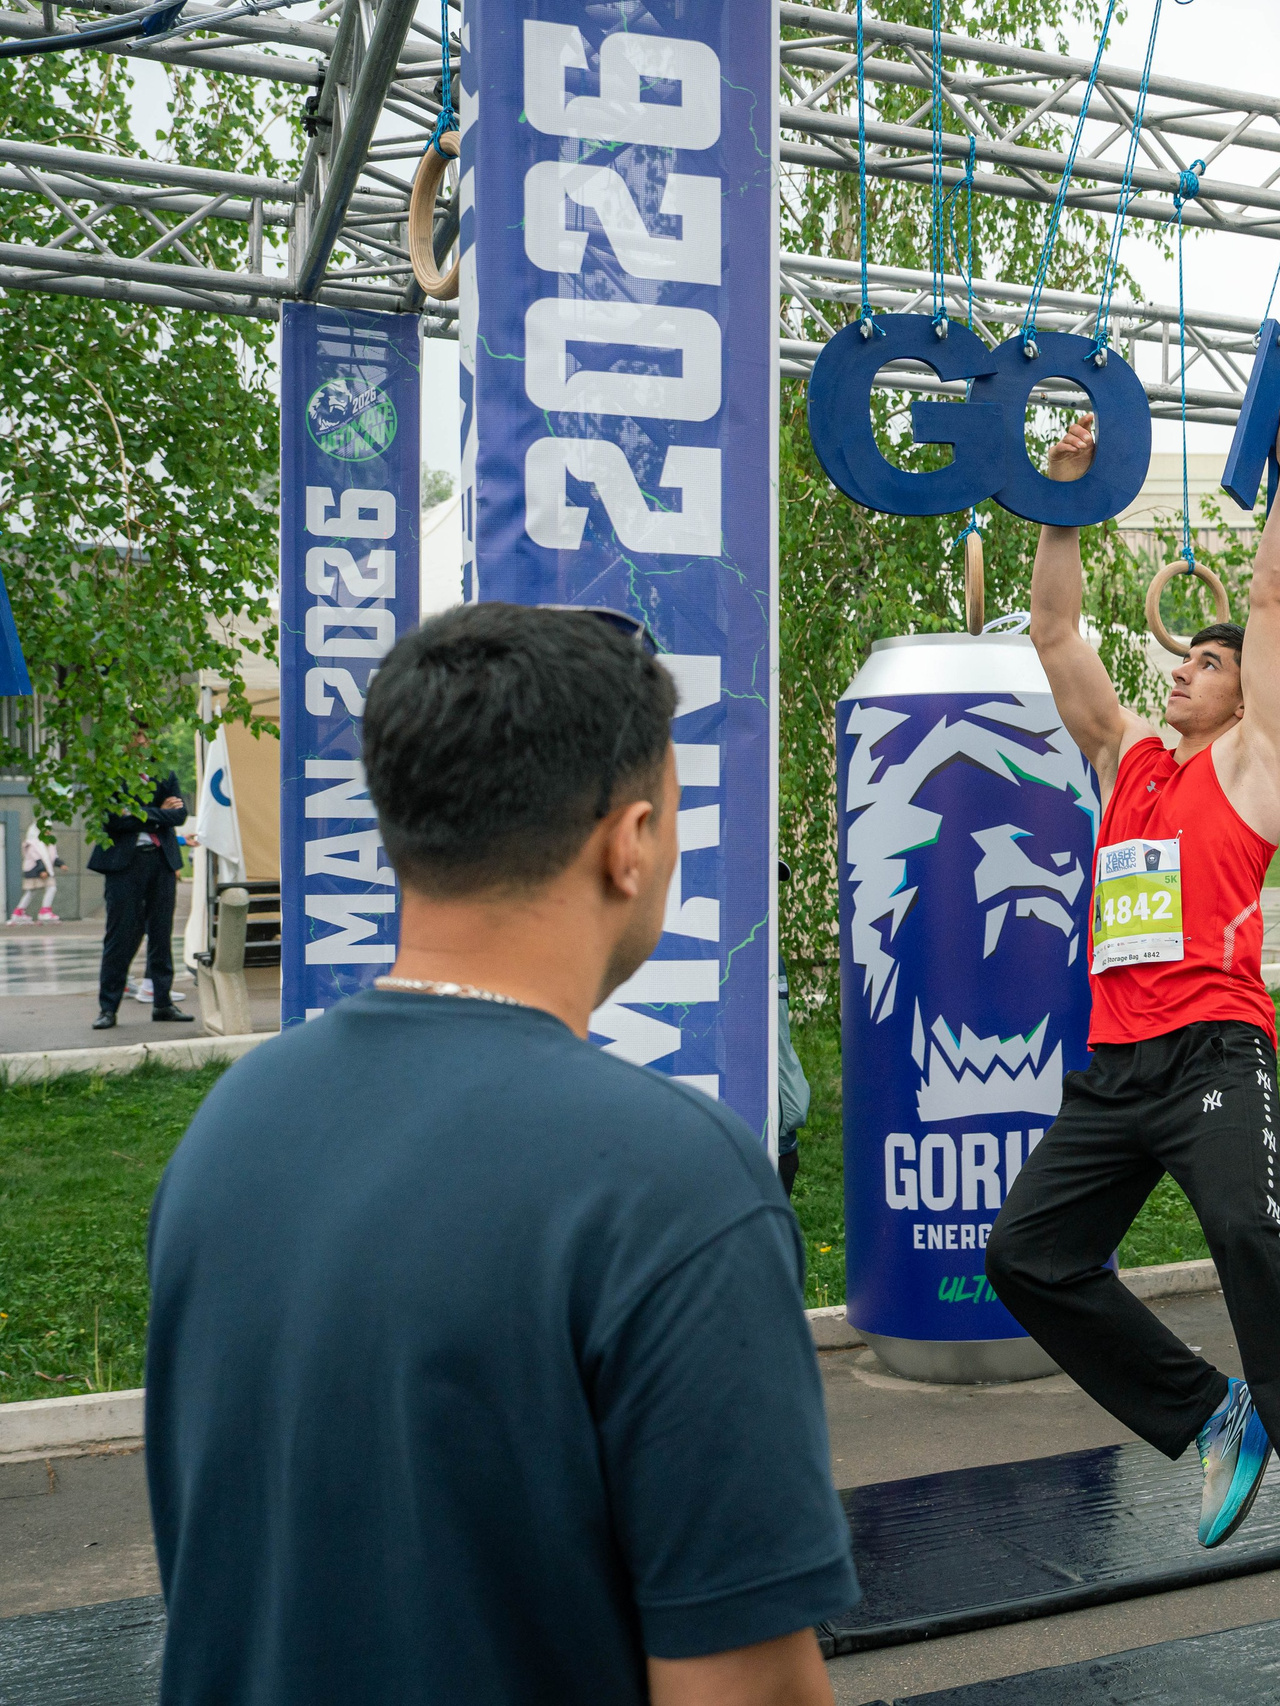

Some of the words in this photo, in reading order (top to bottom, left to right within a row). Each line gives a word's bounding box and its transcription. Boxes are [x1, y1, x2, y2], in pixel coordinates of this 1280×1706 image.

[524, 19, 721, 556] 2026
[352, 387, 377, 414] 2026
[305, 486, 396, 717] 2026
[305, 759, 396, 965] MAN
[1105, 858, 1130, 871] KENT
[1106, 848, 1131, 865] TASH
[1164, 875, 1178, 884] 5K
[1103, 891, 1173, 927] 4842
[1128, 953, 1139, 961] Bag
